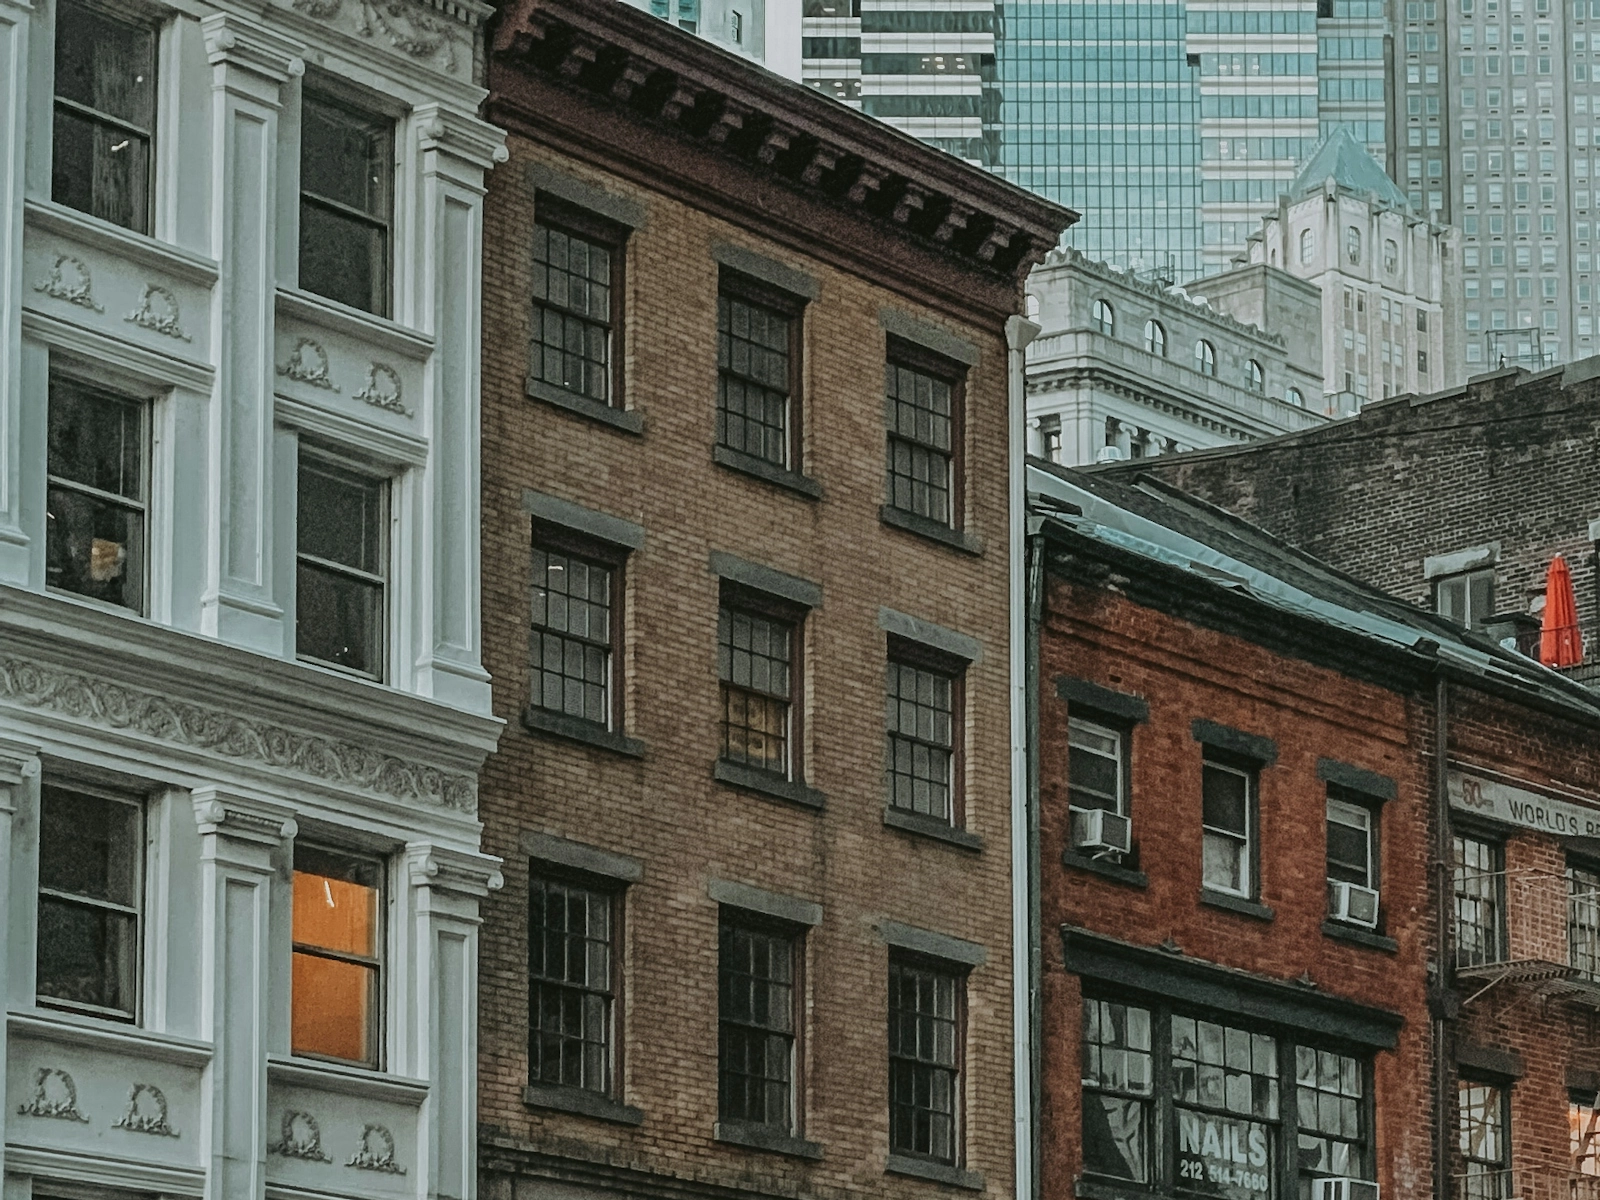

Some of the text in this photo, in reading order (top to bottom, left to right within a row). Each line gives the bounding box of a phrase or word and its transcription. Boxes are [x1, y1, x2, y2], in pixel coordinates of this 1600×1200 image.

[1508, 799, 1579, 836] WORLD'S
[1180, 1115, 1267, 1167] NAILS
[1180, 1159, 1268, 1192] 212 514-7660
